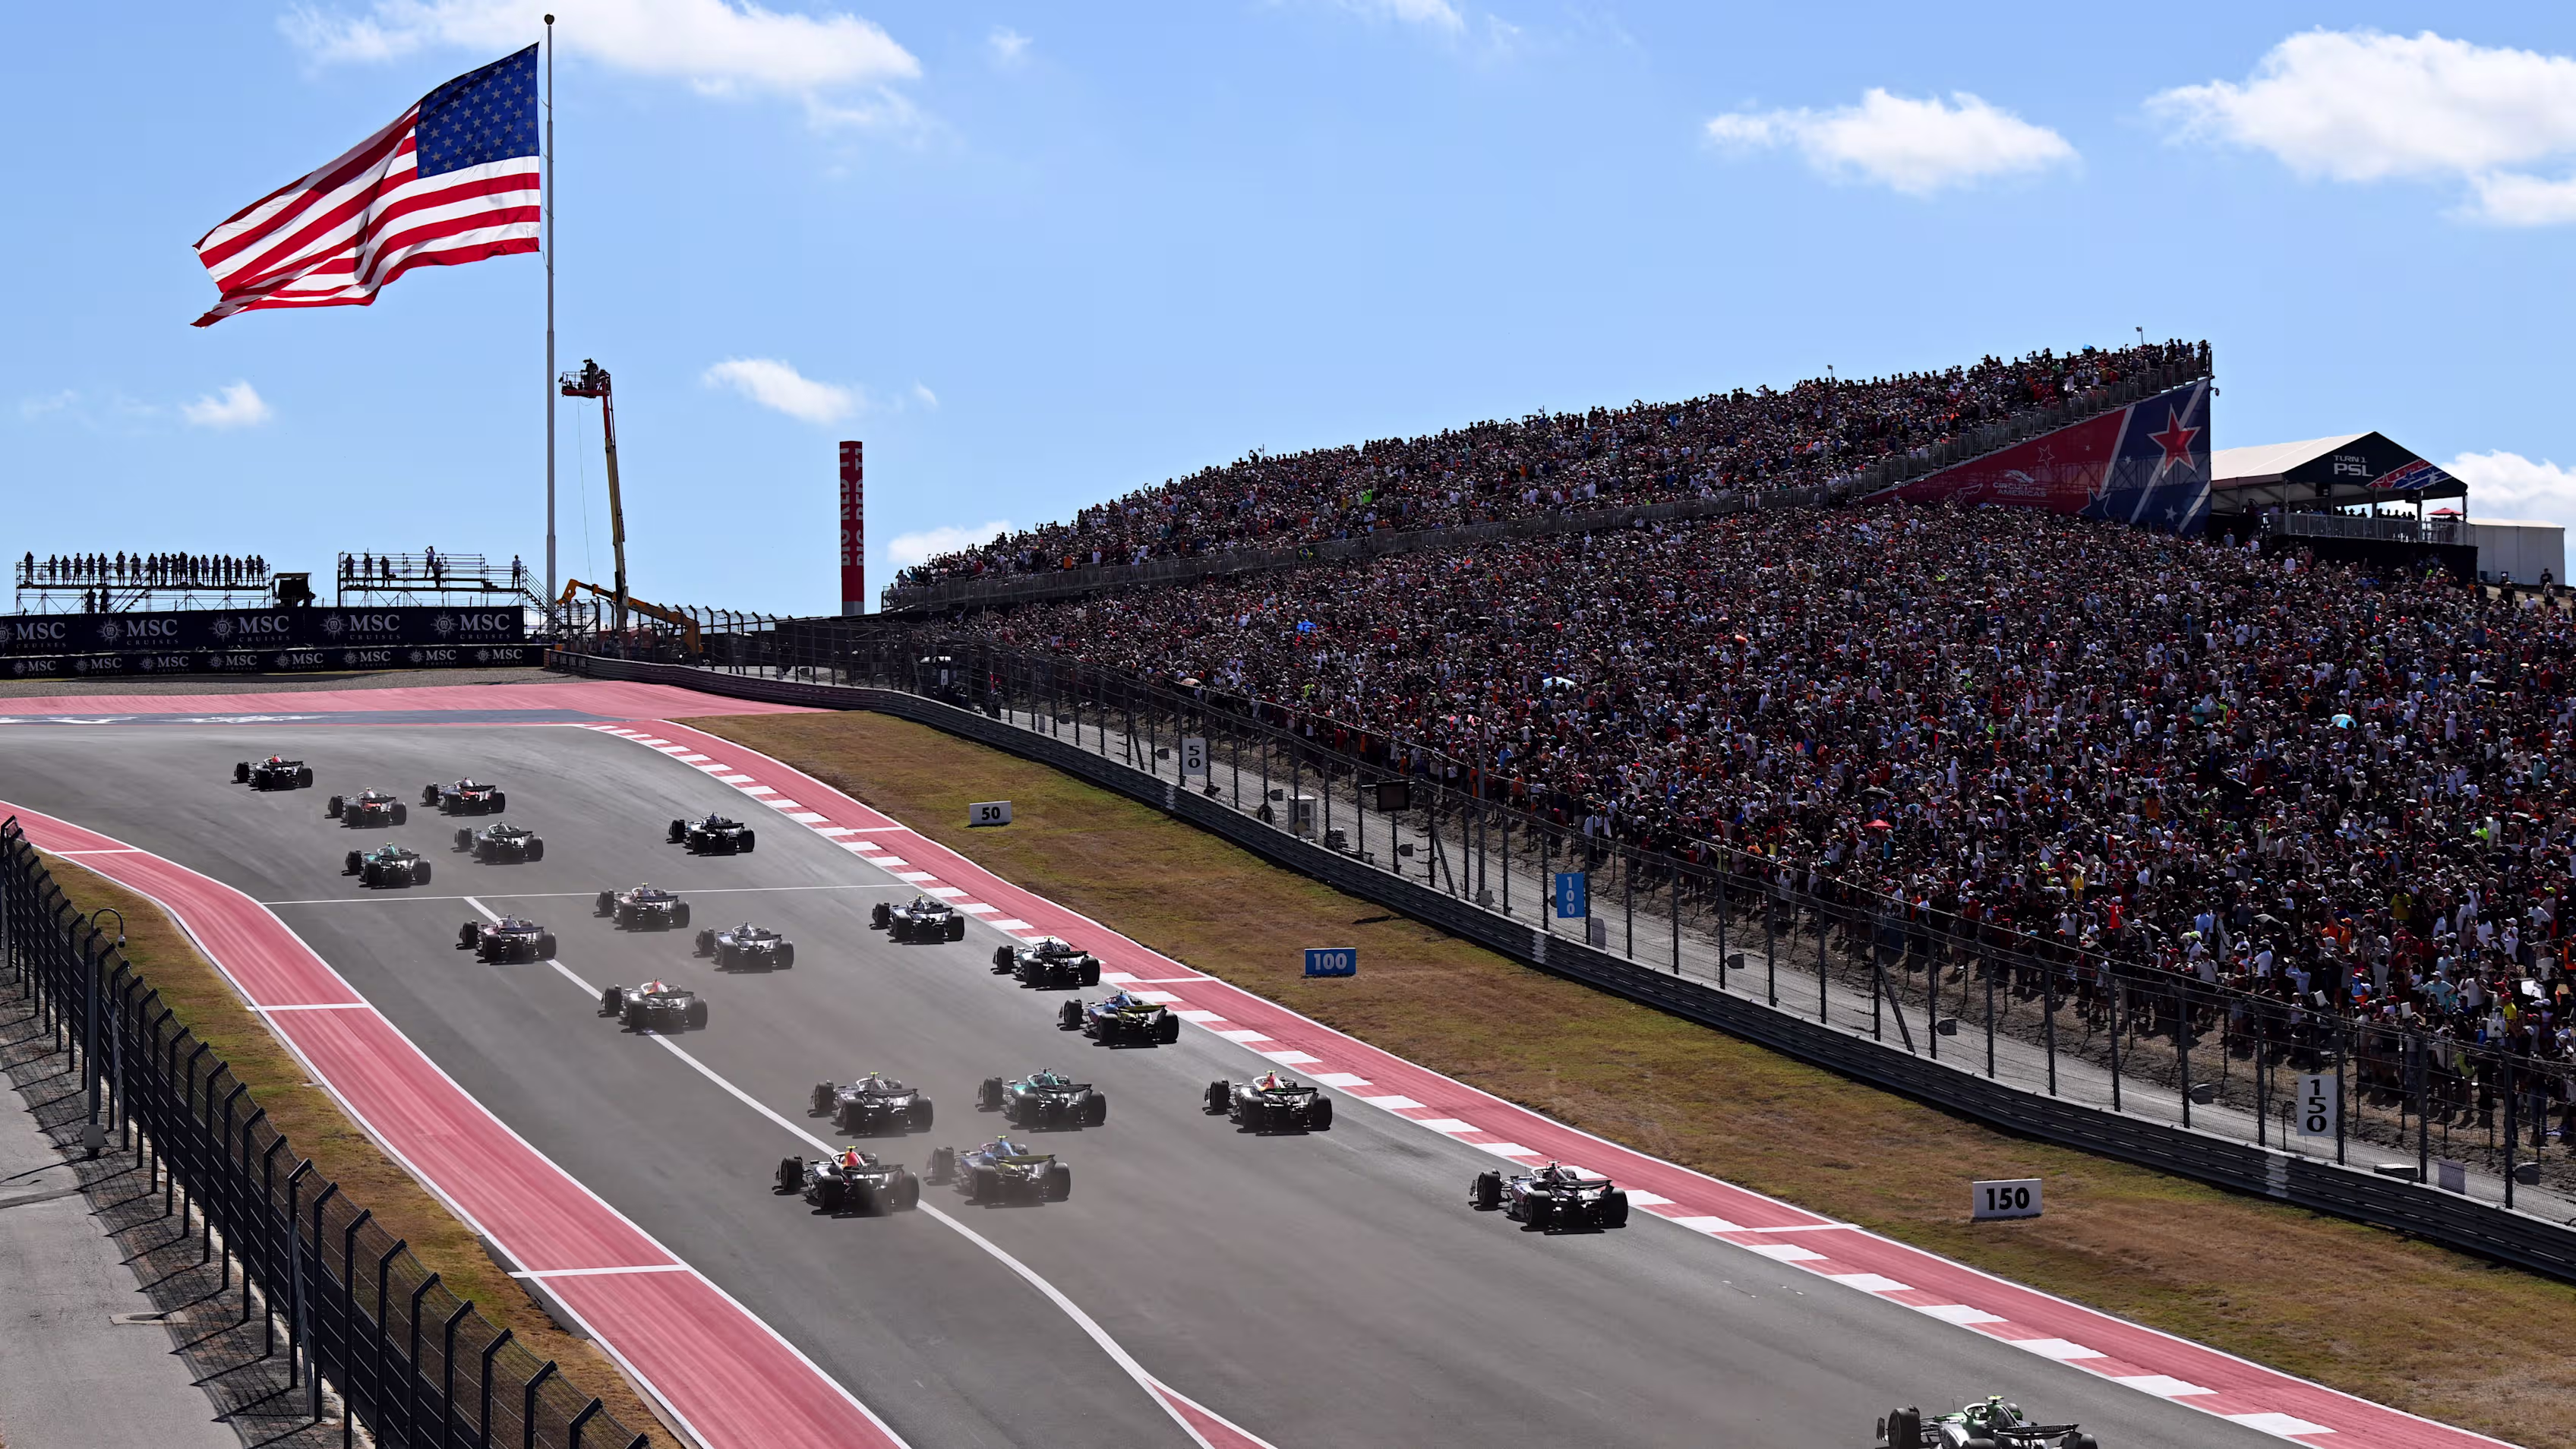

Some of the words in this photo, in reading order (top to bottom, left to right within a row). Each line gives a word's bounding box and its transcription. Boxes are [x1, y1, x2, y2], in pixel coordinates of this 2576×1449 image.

[2334, 463, 2374, 477] PSL
[1993, 482, 2028, 491] CIRCUIT
[1997, 489, 2047, 497] AMERICAS
[126, 619, 178, 637] MSC
[238, 615, 289, 633] MSC
[349, 614, 400, 631] MSC
[459, 614, 510, 631] MSC
[16, 622, 65, 640] MSC
[226, 655, 257, 666] MSC
[292, 653, 324, 665] MSC
[360, 651, 391, 662] MSC
[426, 649, 456, 661] MSC
[493, 649, 522, 659] MSC
[27, 661, 56, 671] MSC
[90, 658, 122, 669] MSC
[157, 656, 189, 668] MSC
[1188, 745, 1201, 769] 50
[981, 807, 1001, 820] 50
[1566, 876, 1575, 915] 100
[1314, 952, 1347, 970] 100
[2306, 1079, 2327, 1132] 150
[1987, 1187, 2029, 1211] 150
